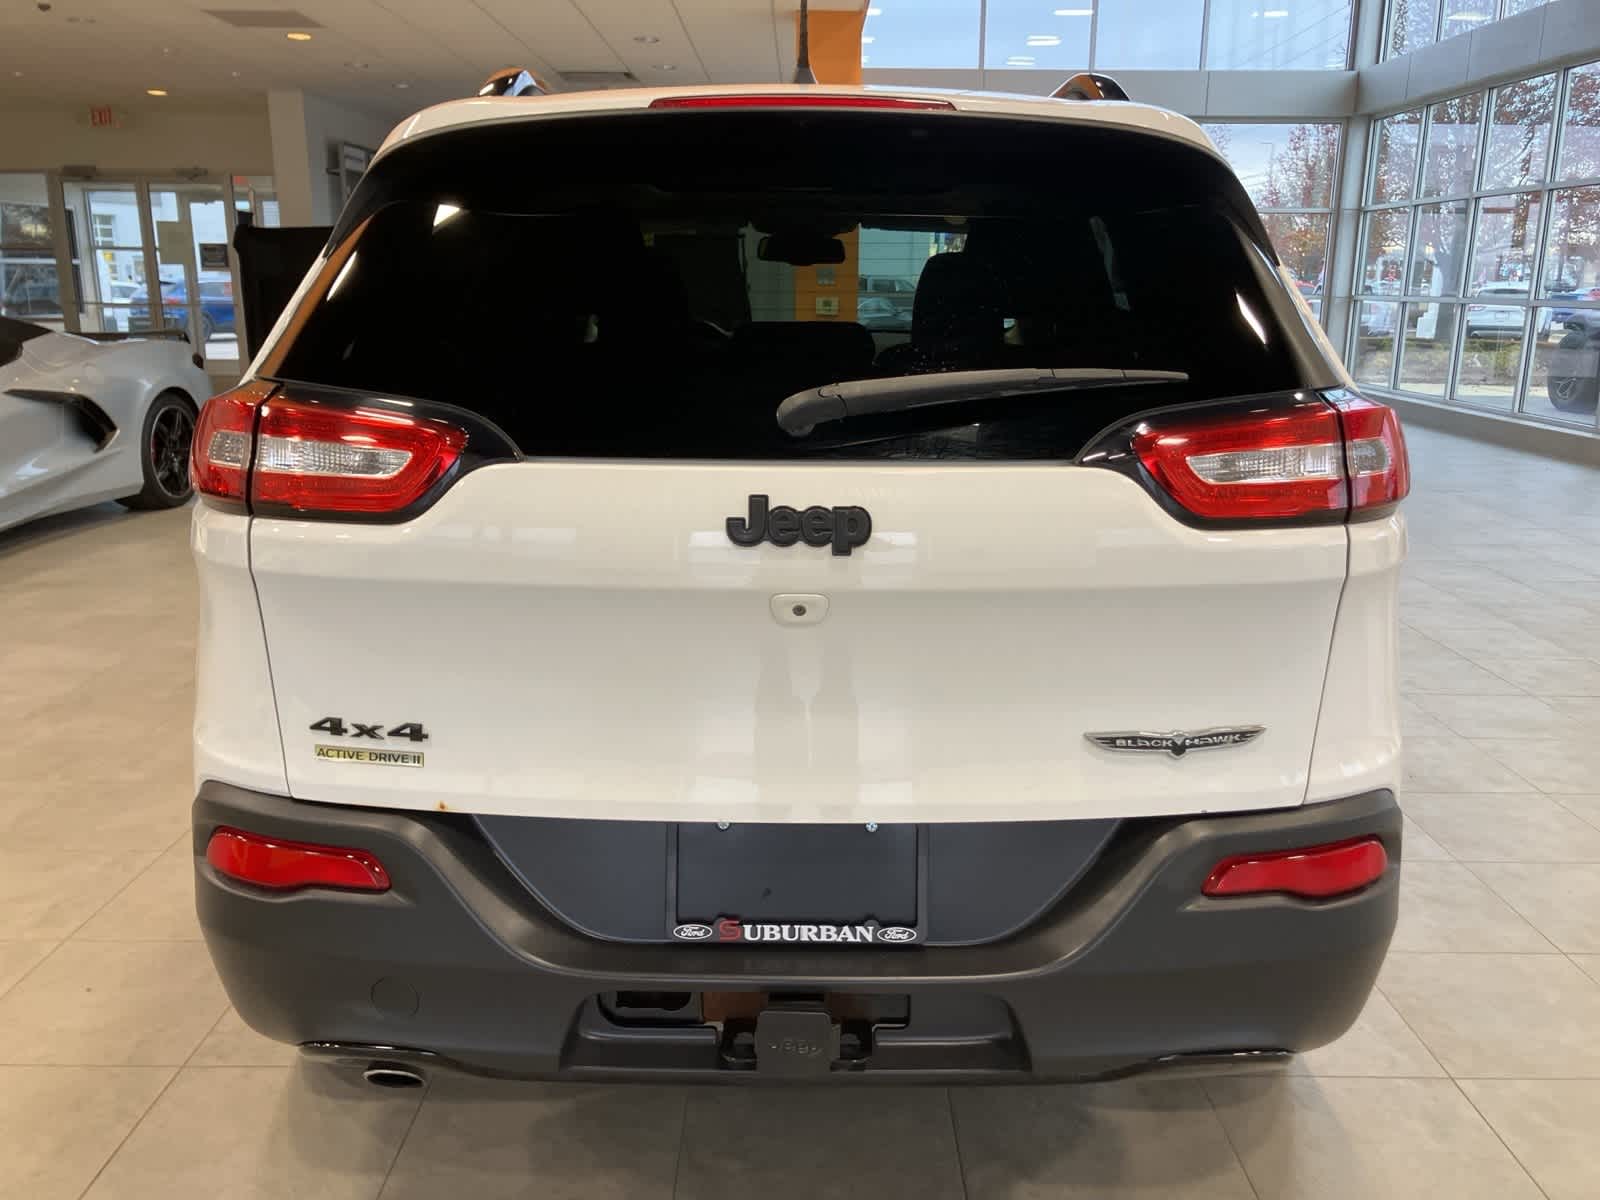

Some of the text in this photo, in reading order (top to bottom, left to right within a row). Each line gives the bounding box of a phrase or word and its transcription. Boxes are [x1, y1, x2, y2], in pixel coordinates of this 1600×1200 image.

[725, 494, 872, 556] Jeep
[309, 717, 429, 742] 4x4
[1114, 737, 1173, 748] BLACK
[316, 747, 365, 761] ACTIVE
[369, 752, 410, 764] DRIVE
[719, 920, 874, 942] SUBURBAN
